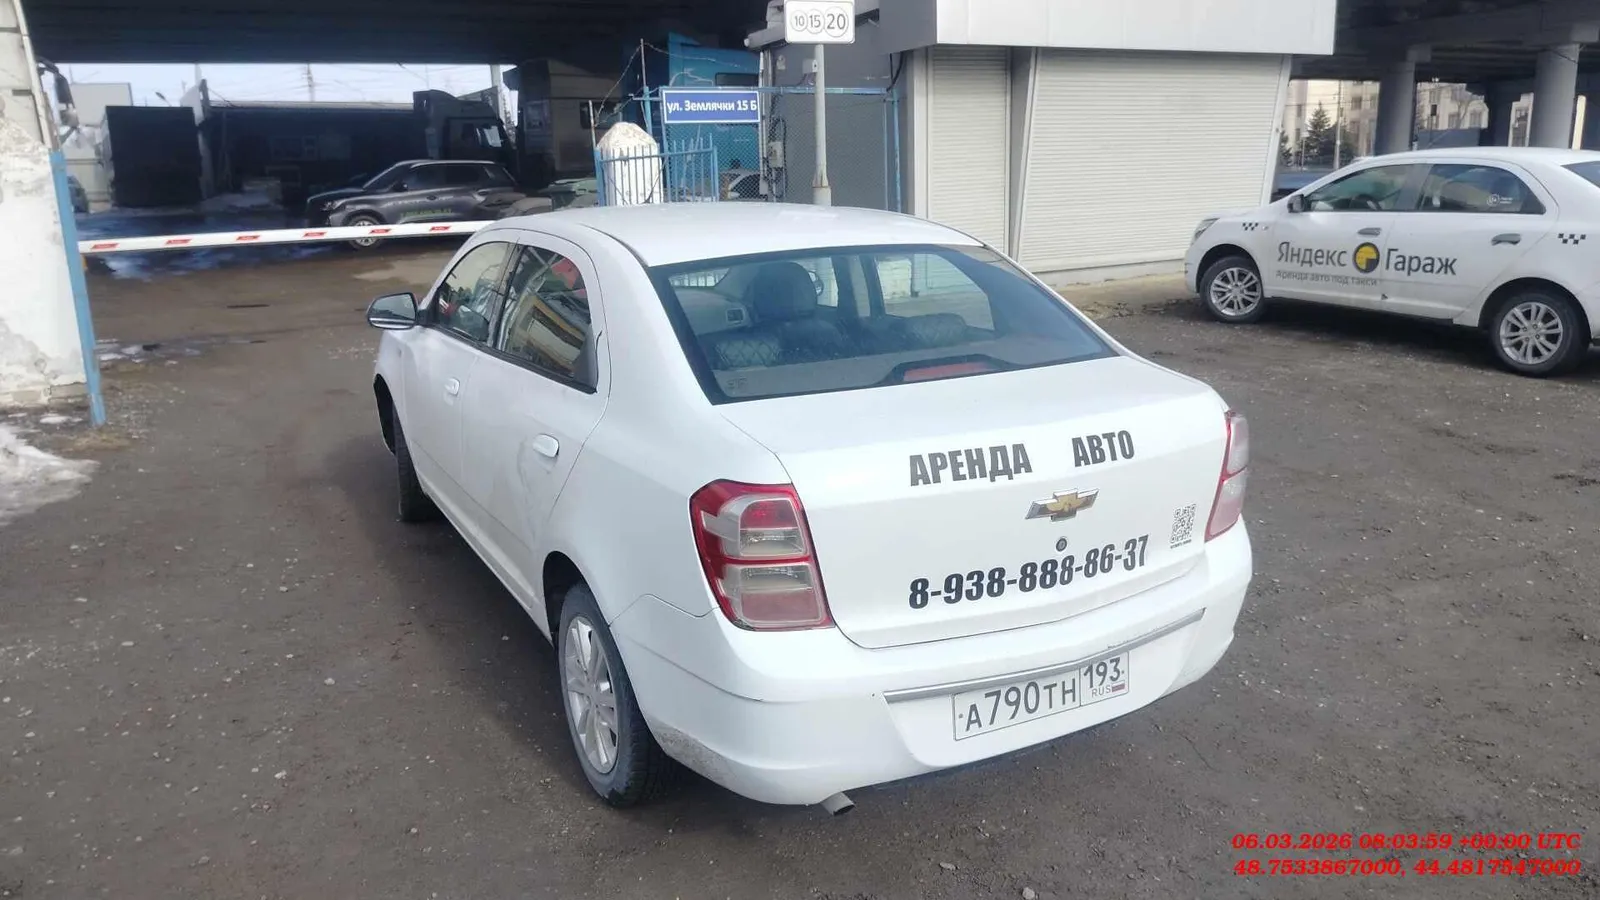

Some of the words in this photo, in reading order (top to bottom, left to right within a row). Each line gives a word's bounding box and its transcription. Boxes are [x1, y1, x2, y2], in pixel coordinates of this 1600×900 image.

[795, 16, 805, 26] 10
[809, 15, 821, 28] 15
[827, 13, 846, 30] 20
[667, 102, 682, 114] ул.
[684, 100, 735, 112] Землячки
[737, 99, 748, 111] 15
[1277, 241, 1348, 267] Яндекс
[1385, 248, 1458, 276] Гараж
[909, 443, 1033, 486] АРЕНДА
[1072, 430, 1135, 467] АВТО
[908, 534, 1149, 609] 8-938-888-86-37
[1083, 656, 1121, 689] 193
[1092, 686, 1111, 698] RUS
